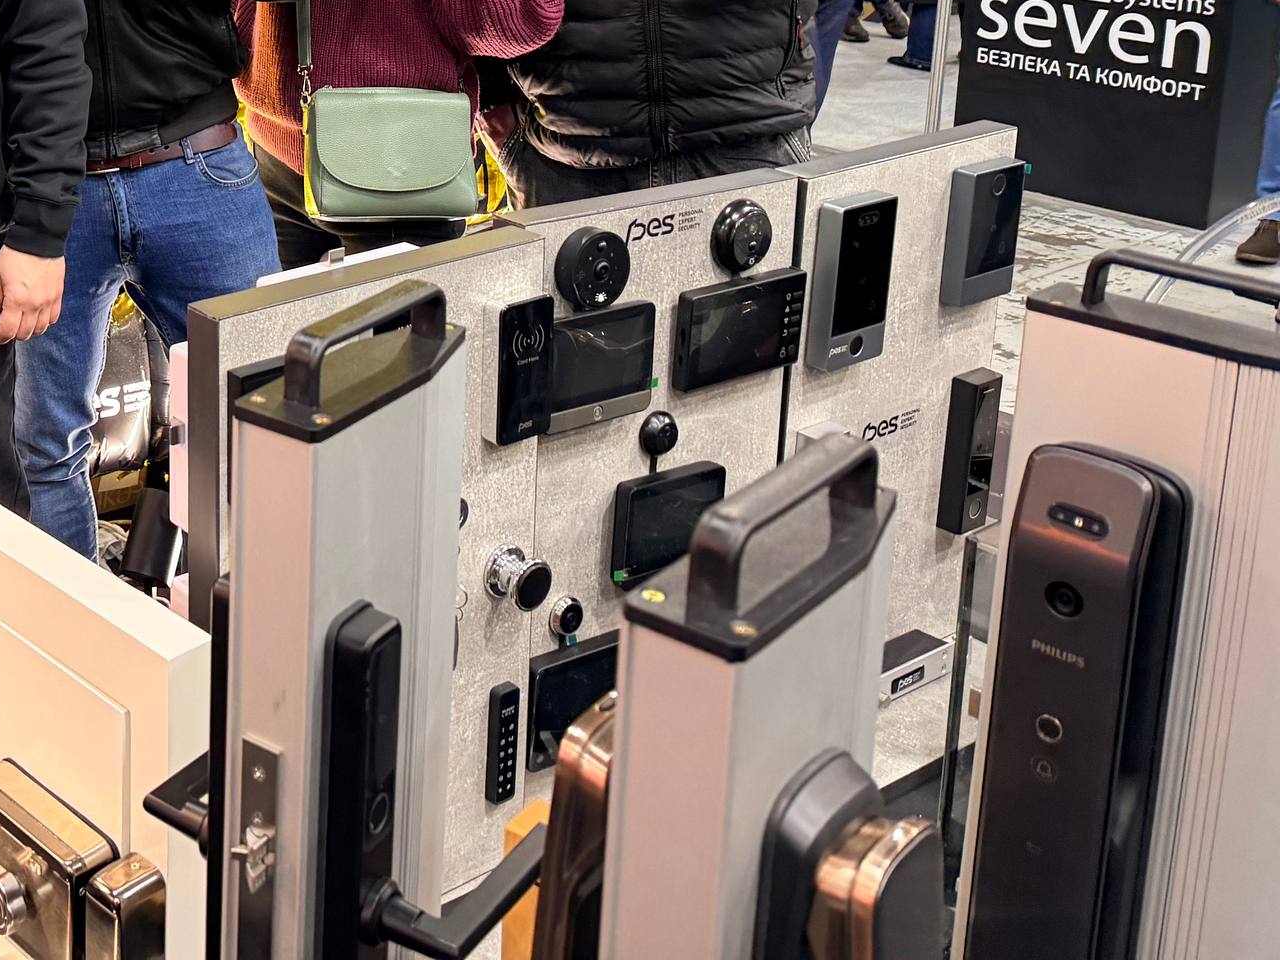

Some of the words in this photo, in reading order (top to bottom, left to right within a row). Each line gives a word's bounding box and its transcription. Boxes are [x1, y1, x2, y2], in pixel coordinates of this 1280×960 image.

[977, 47, 1061, 77] БЕЗПЕКА
[1066, 62, 1091, 82] ТА
[1095, 67, 1206, 101] КОМФОРТ
[678, 208, 704, 218] PERSONAL
[678, 222, 701, 232] SECURITY
[625, 214, 676, 248] pes
[1031, 638, 1086, 670] PHILIPS
